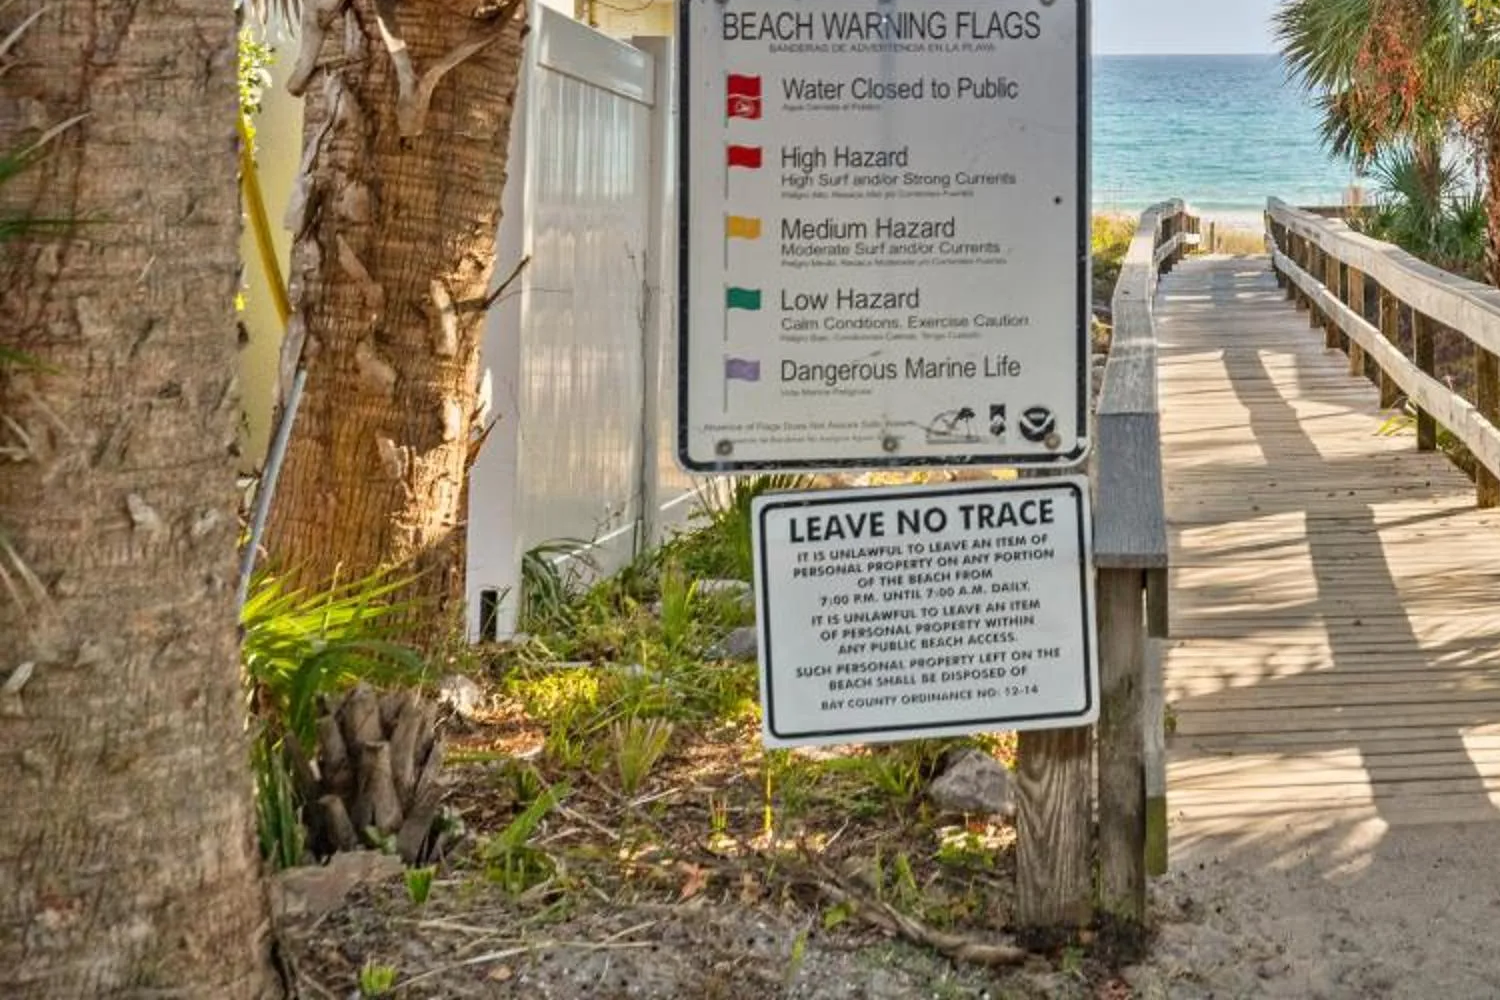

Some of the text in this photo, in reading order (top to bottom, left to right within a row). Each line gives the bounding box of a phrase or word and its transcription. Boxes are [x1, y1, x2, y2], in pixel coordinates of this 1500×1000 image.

[723, 10, 1041, 41] BEACH WARNING FLAGS
[782, 76, 1019, 100] Water Closed to Public
[781, 145, 909, 173] High Hazard
[781, 171, 1017, 189] High Surf and/or Strong Currents
[780, 216, 956, 241] Medium Hazard
[781, 241, 1000, 257] Moderate Surf and/or Currents
[781, 287, 920, 311] Low Hazard
[781, 317, 819, 331] Calm
[907, 314, 969, 329] Exercise
[973, 313, 1030, 327] Caution
[781, 354, 1021, 386] Dangerous Marine Life
[789, 498, 1055, 543] LEAVE NO TRACE
[797, 533, 1048, 563] IT IS UNLAWFUL TO LEAVE AN ITEM OF
[793, 548, 1055, 578] PERSONAL PROPERTY ON ANY PORTION
[858, 568, 993, 588] OF THE BEACH FROM
[883, 590, 921, 601] UNTIL
[811, 599, 1041, 626] IT IS UNLAWFUL TO LEAVE AN ITEM
[820, 615, 1035, 641] OF PERSONAL PROPERTY WITHIN
[838, 643, 866, 655] ANY
[871, 639, 916, 652] PUBLIC
[921, 635, 963, 649] BEACH
[796, 647, 1060, 678] SUCH PERSONAL PROPERTY LEFT ON THE
[829, 665, 1028, 691] BEACH SHALL BE DISPOSED OF
[821, 700, 844, 711] BAY
[847, 695, 897, 708] COUNTY
[901, 689, 972, 705] ORDINANCE
